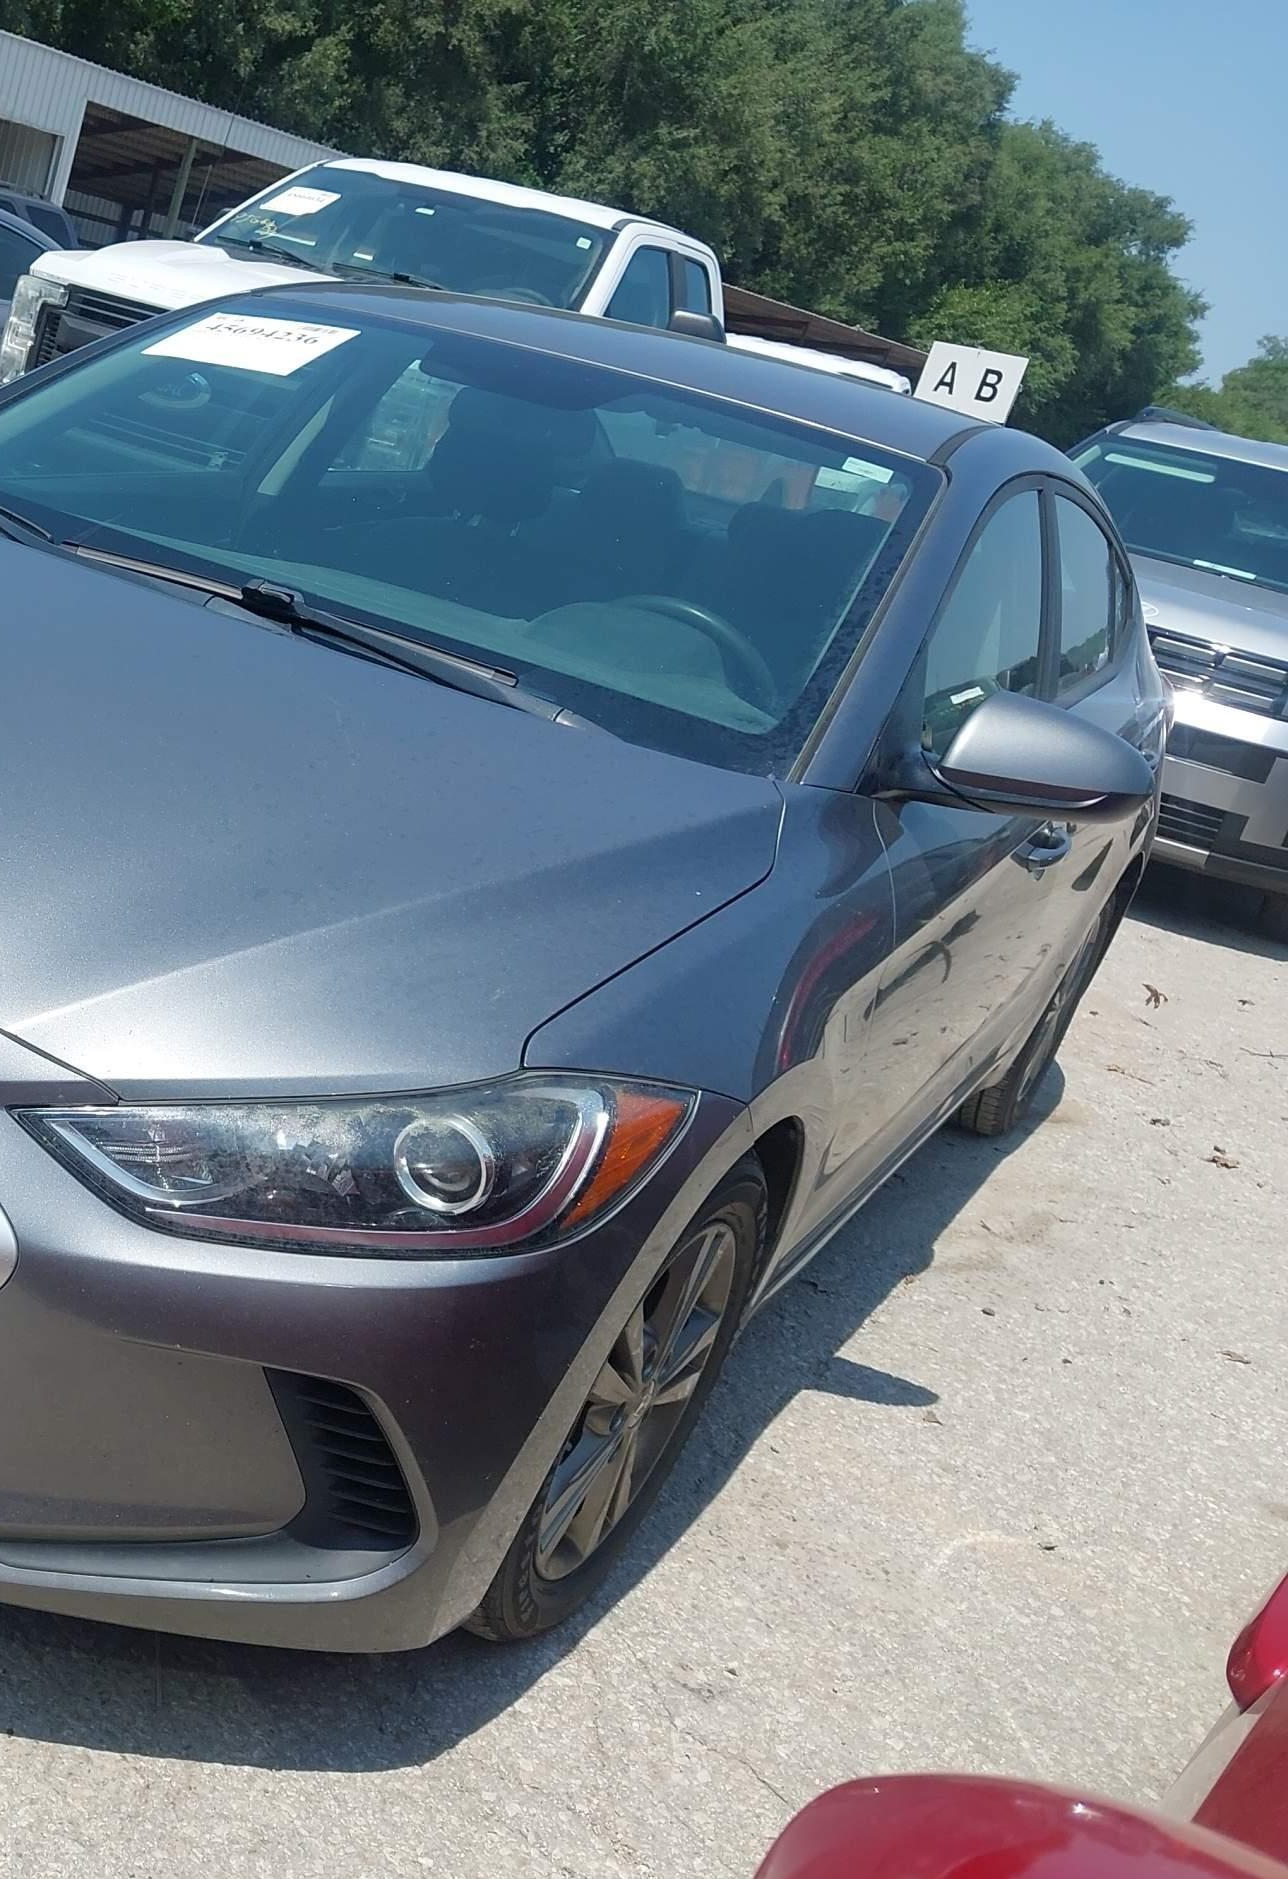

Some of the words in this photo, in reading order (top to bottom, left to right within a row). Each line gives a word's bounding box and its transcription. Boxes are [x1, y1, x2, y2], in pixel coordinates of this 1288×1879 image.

[205, 323, 319, 345] 45694236
[932, 361, 958, 395] A
[974, 367, 1004, 403] B
